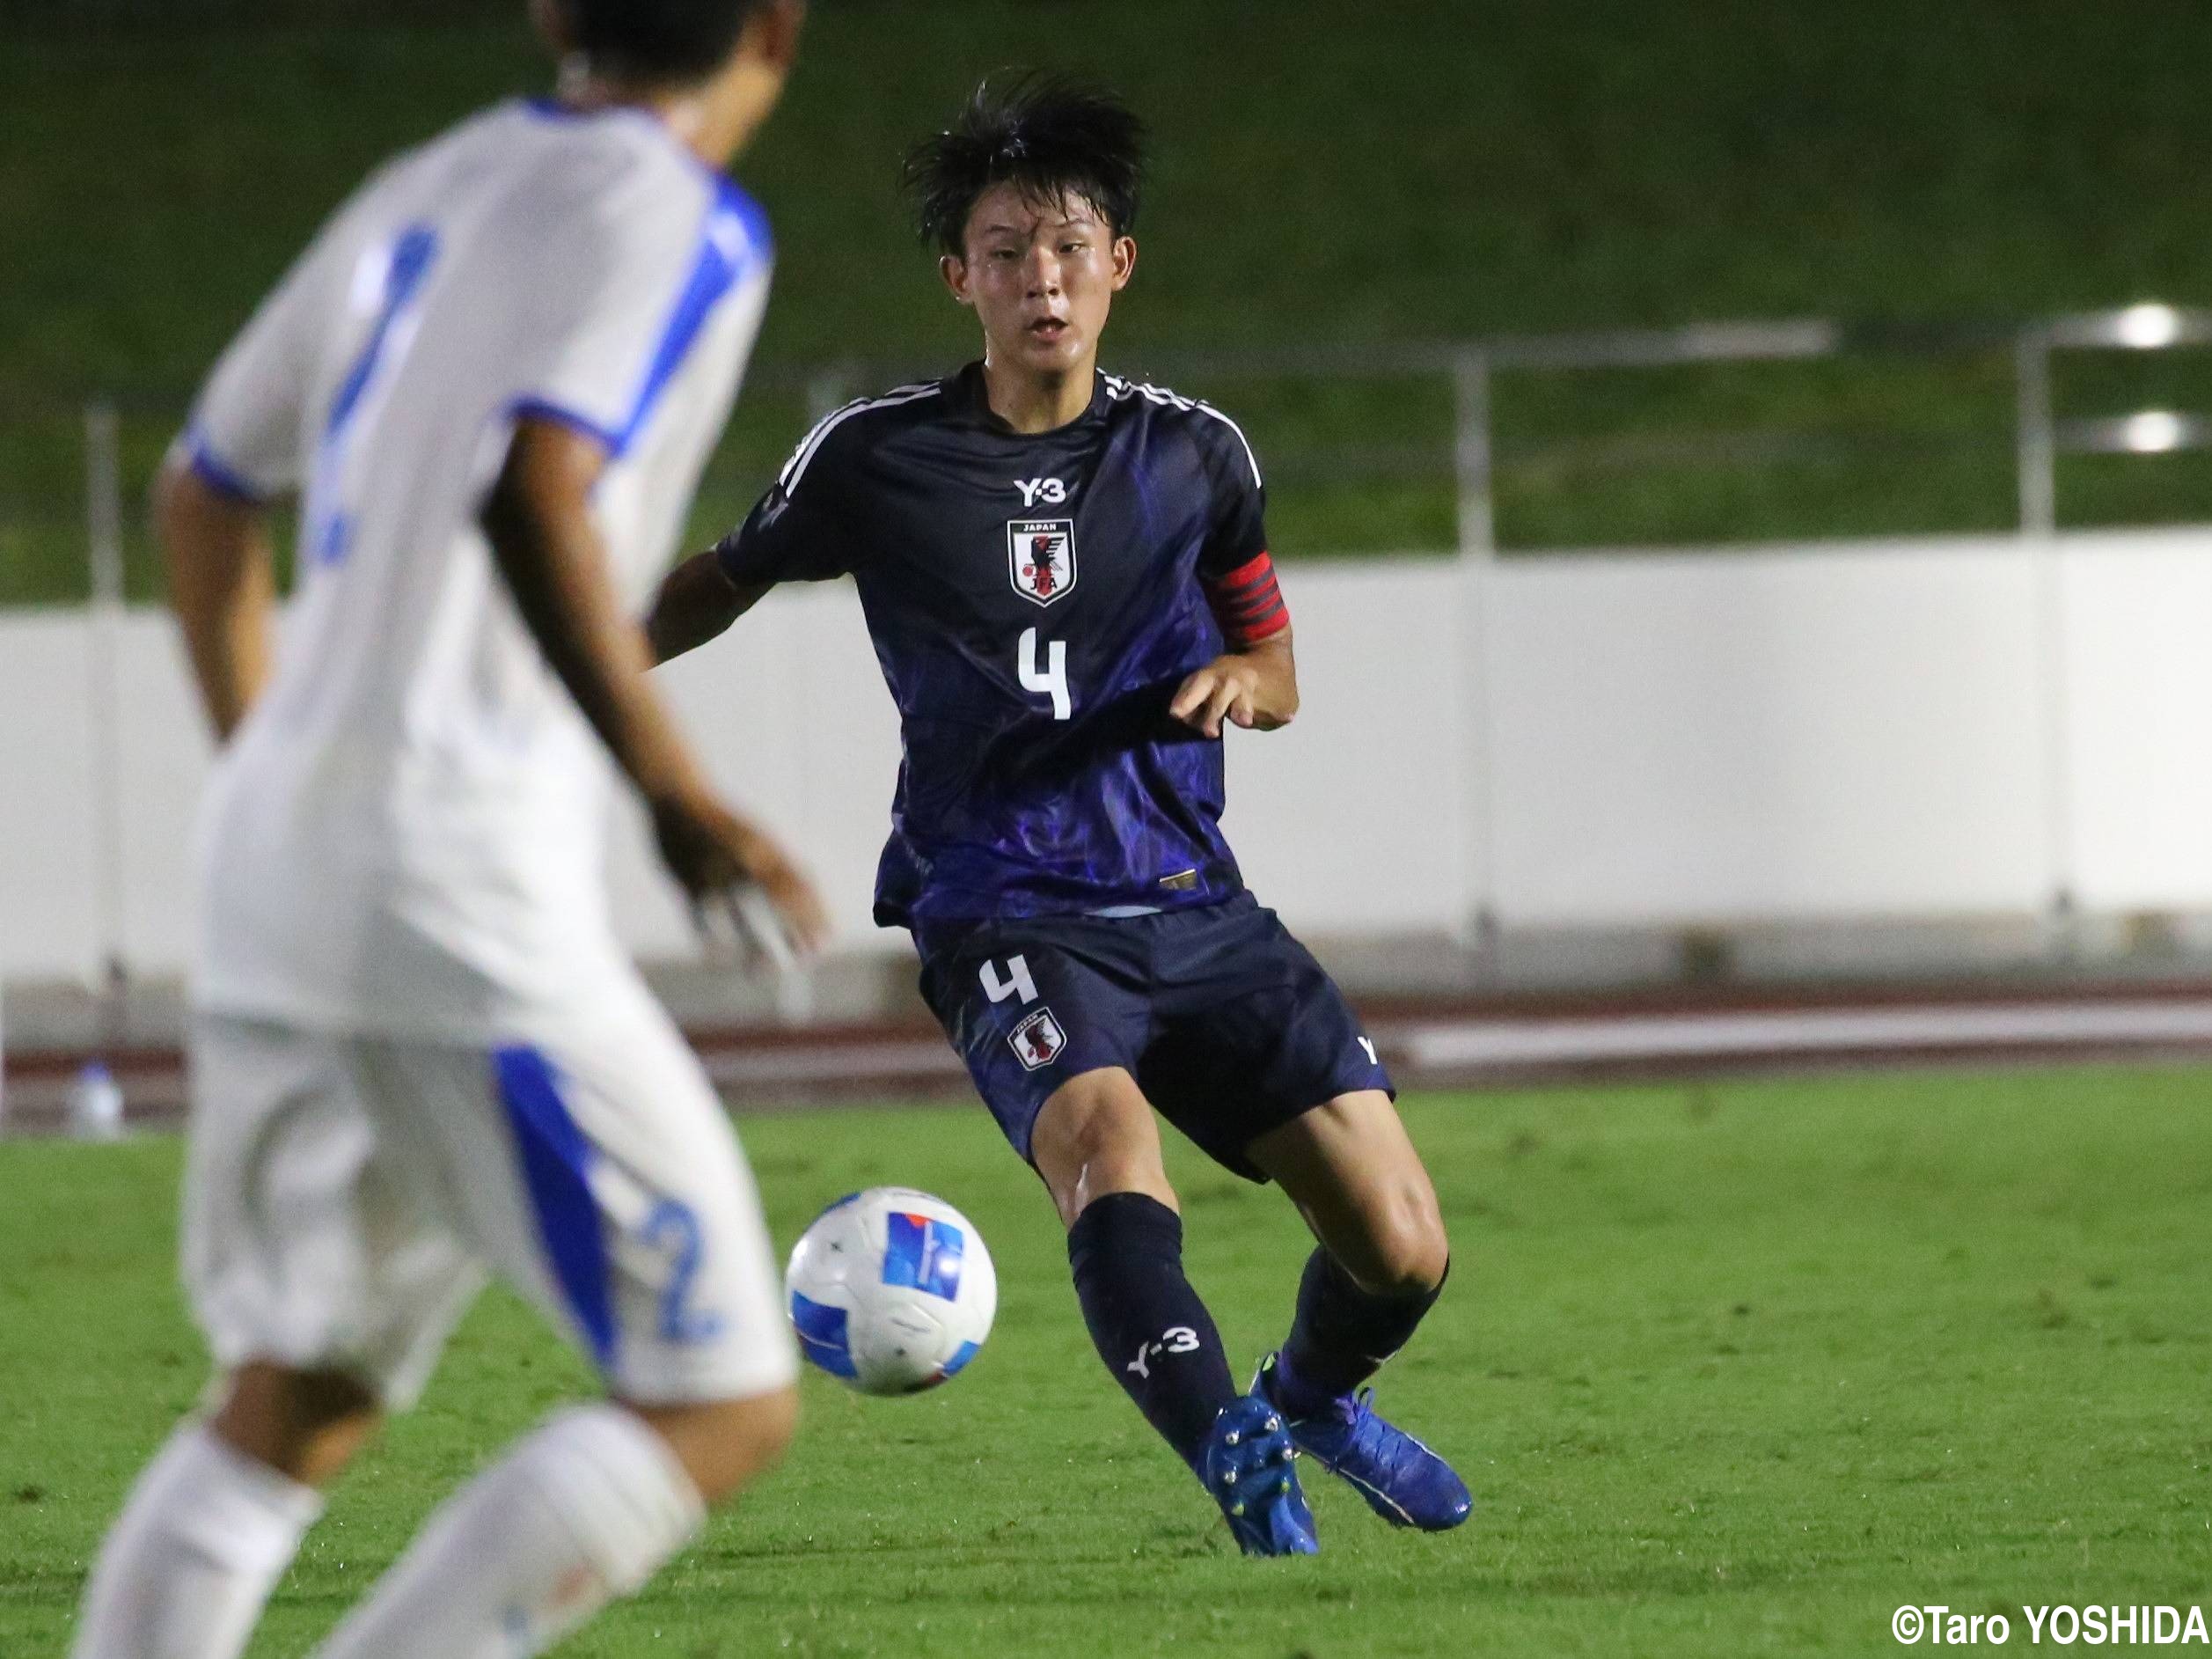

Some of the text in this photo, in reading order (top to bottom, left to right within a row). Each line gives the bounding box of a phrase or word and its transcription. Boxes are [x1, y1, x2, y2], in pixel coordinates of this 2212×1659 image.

[1014, 478, 1066, 507] Y-3
[1023, 523, 1057, 532] JAPAN
[1018, 627, 1072, 719] 4
[978, 954, 1038, 1005] 4
[641, 1199, 729, 1347] 2
[1127, 1326, 1200, 1379] Y-3
